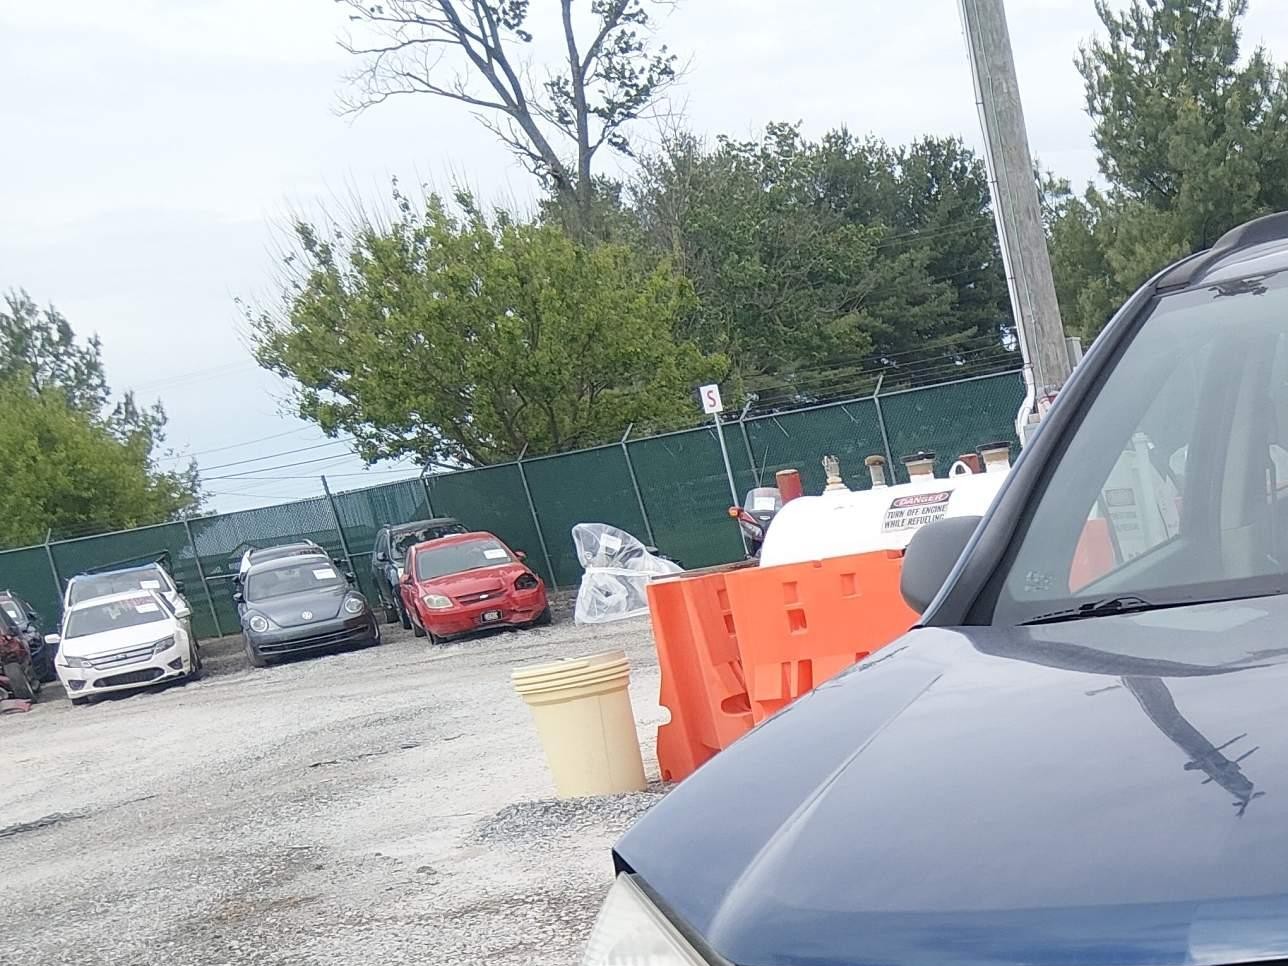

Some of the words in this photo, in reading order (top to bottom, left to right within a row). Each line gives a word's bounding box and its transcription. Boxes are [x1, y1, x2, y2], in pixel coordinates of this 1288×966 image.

[706, 390, 717, 408] S
[899, 493, 944, 506] DANGER
[887, 510, 905, 519] TURN
[907, 508, 921, 517] OFF
[922, 504, 945, 515] ENGINE
[884, 518, 906, 529] WHILE
